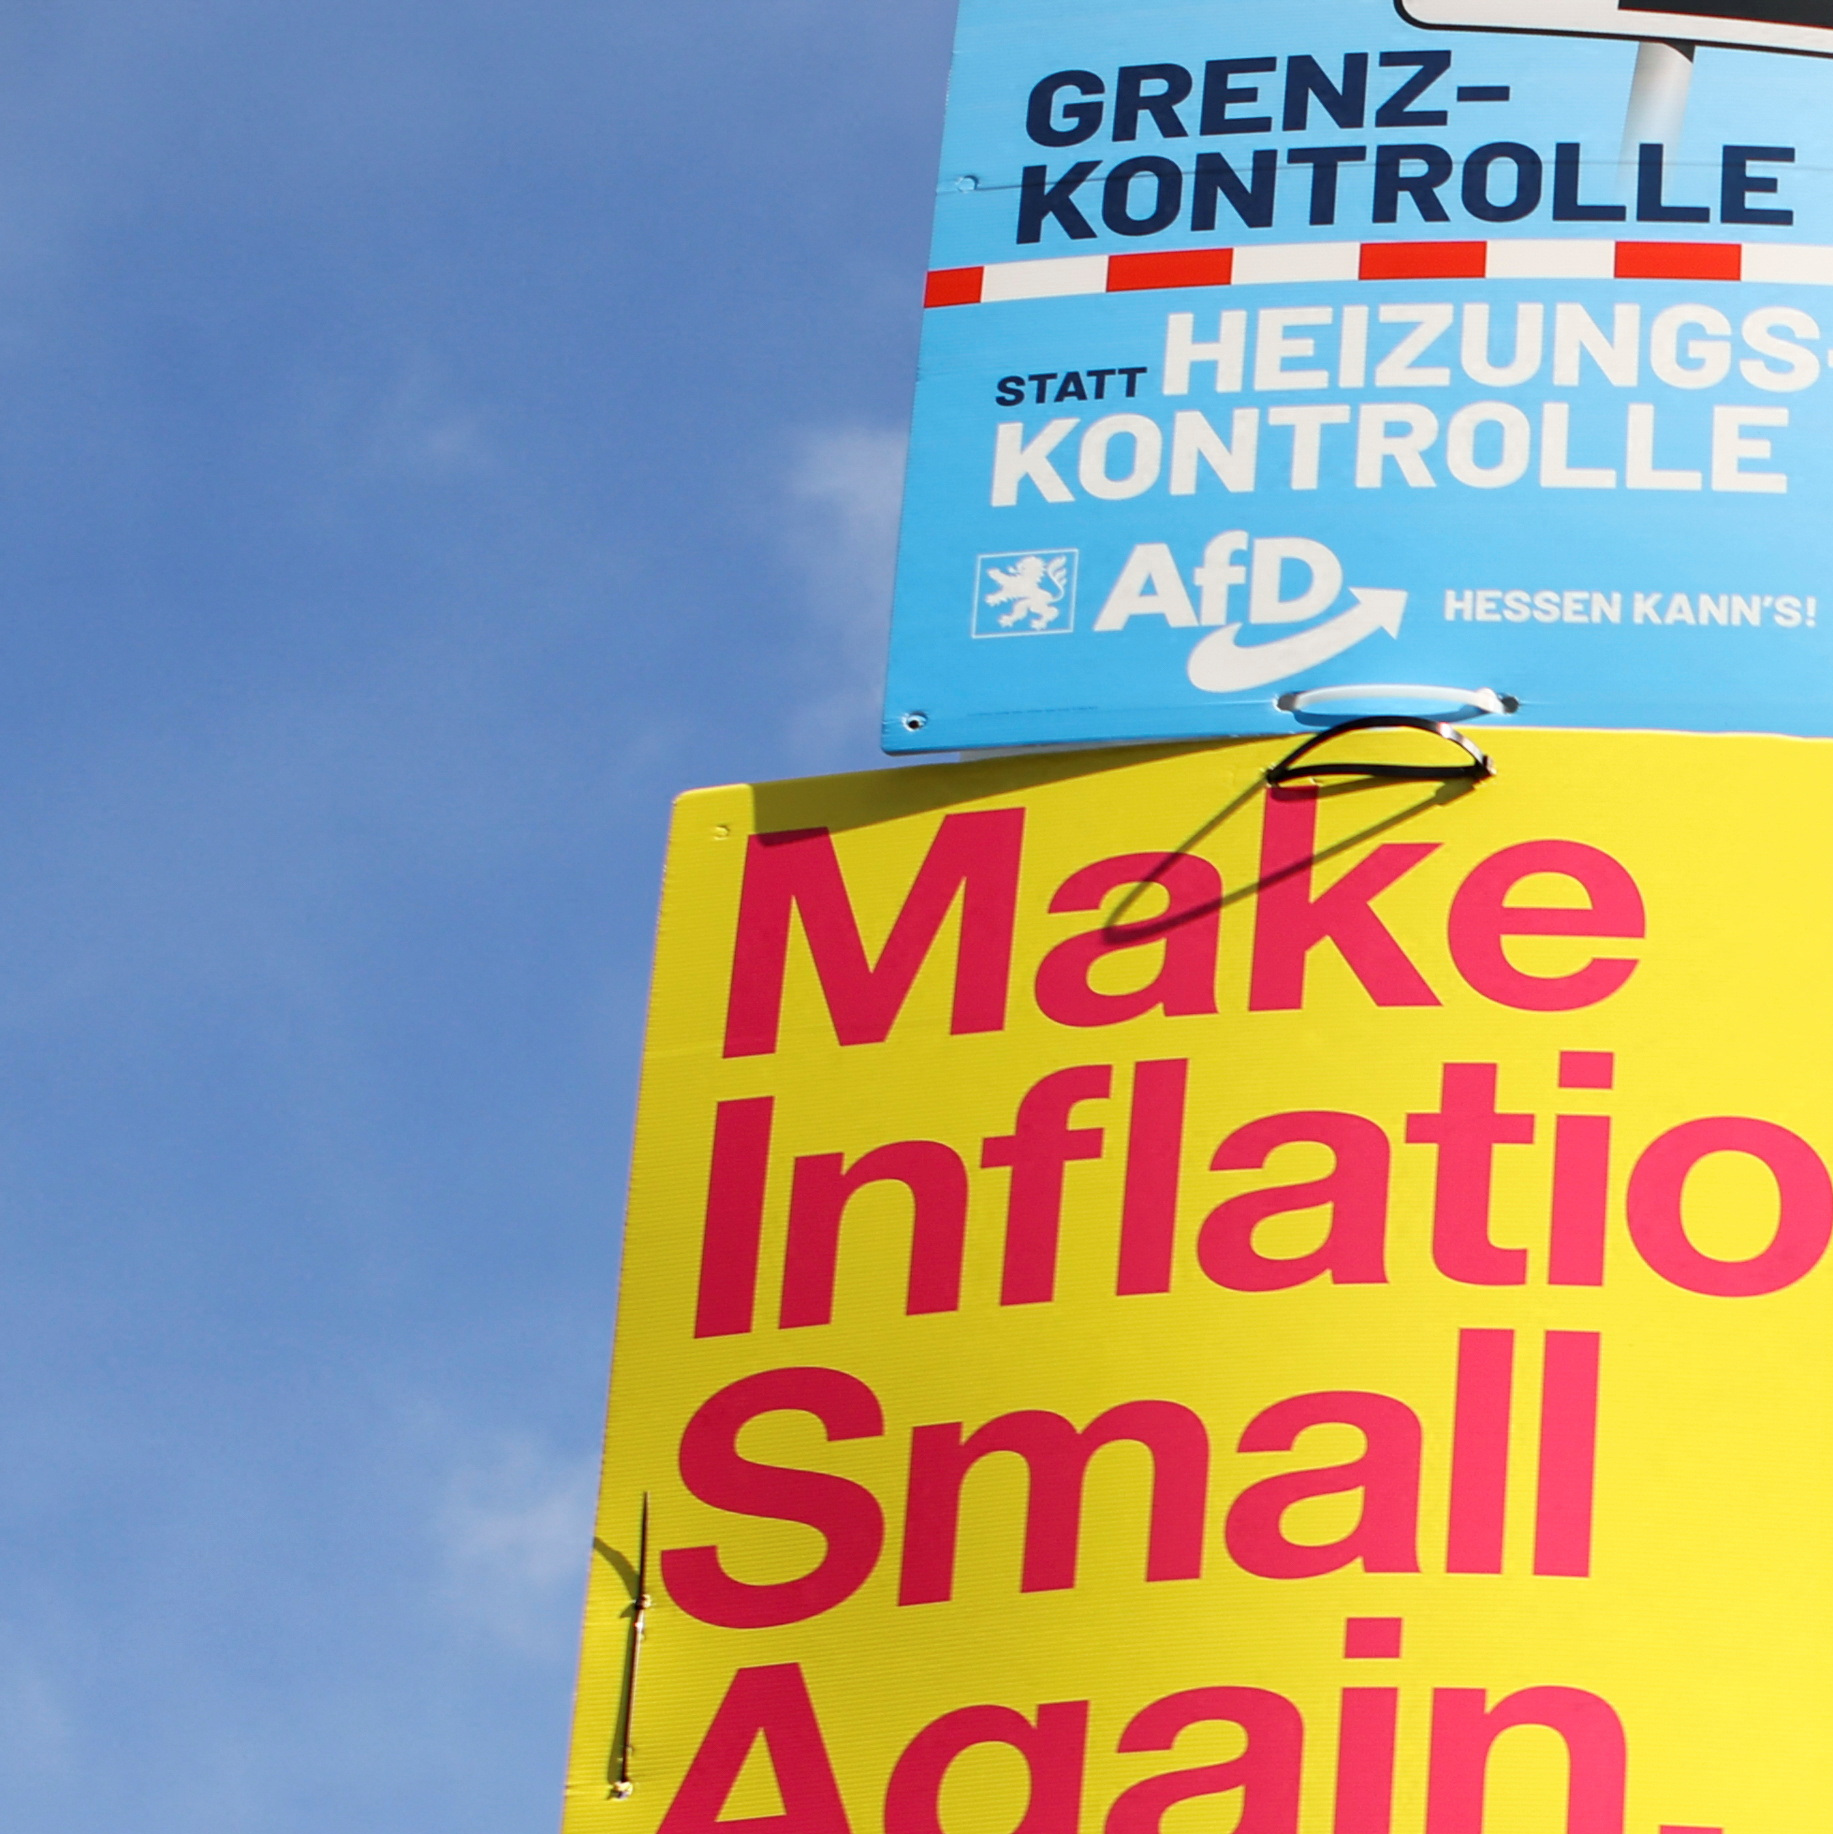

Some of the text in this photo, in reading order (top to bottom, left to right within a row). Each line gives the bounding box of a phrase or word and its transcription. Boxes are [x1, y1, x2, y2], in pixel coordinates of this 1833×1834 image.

[1025, 49, 1511, 149] GRENZ-
[1015, 141, 1796, 246] KONTROLLE
[994, 365, 1148, 408] STATT
[990, 400, 1790, 507] KONTROLLE
[1093, 529, 1344, 632] AfD
[1443, 588, 1818, 628] HESSEN KANN'S!
[721, 785, 1647, 1060] Make
[658, 1328, 1601, 1631] Small
